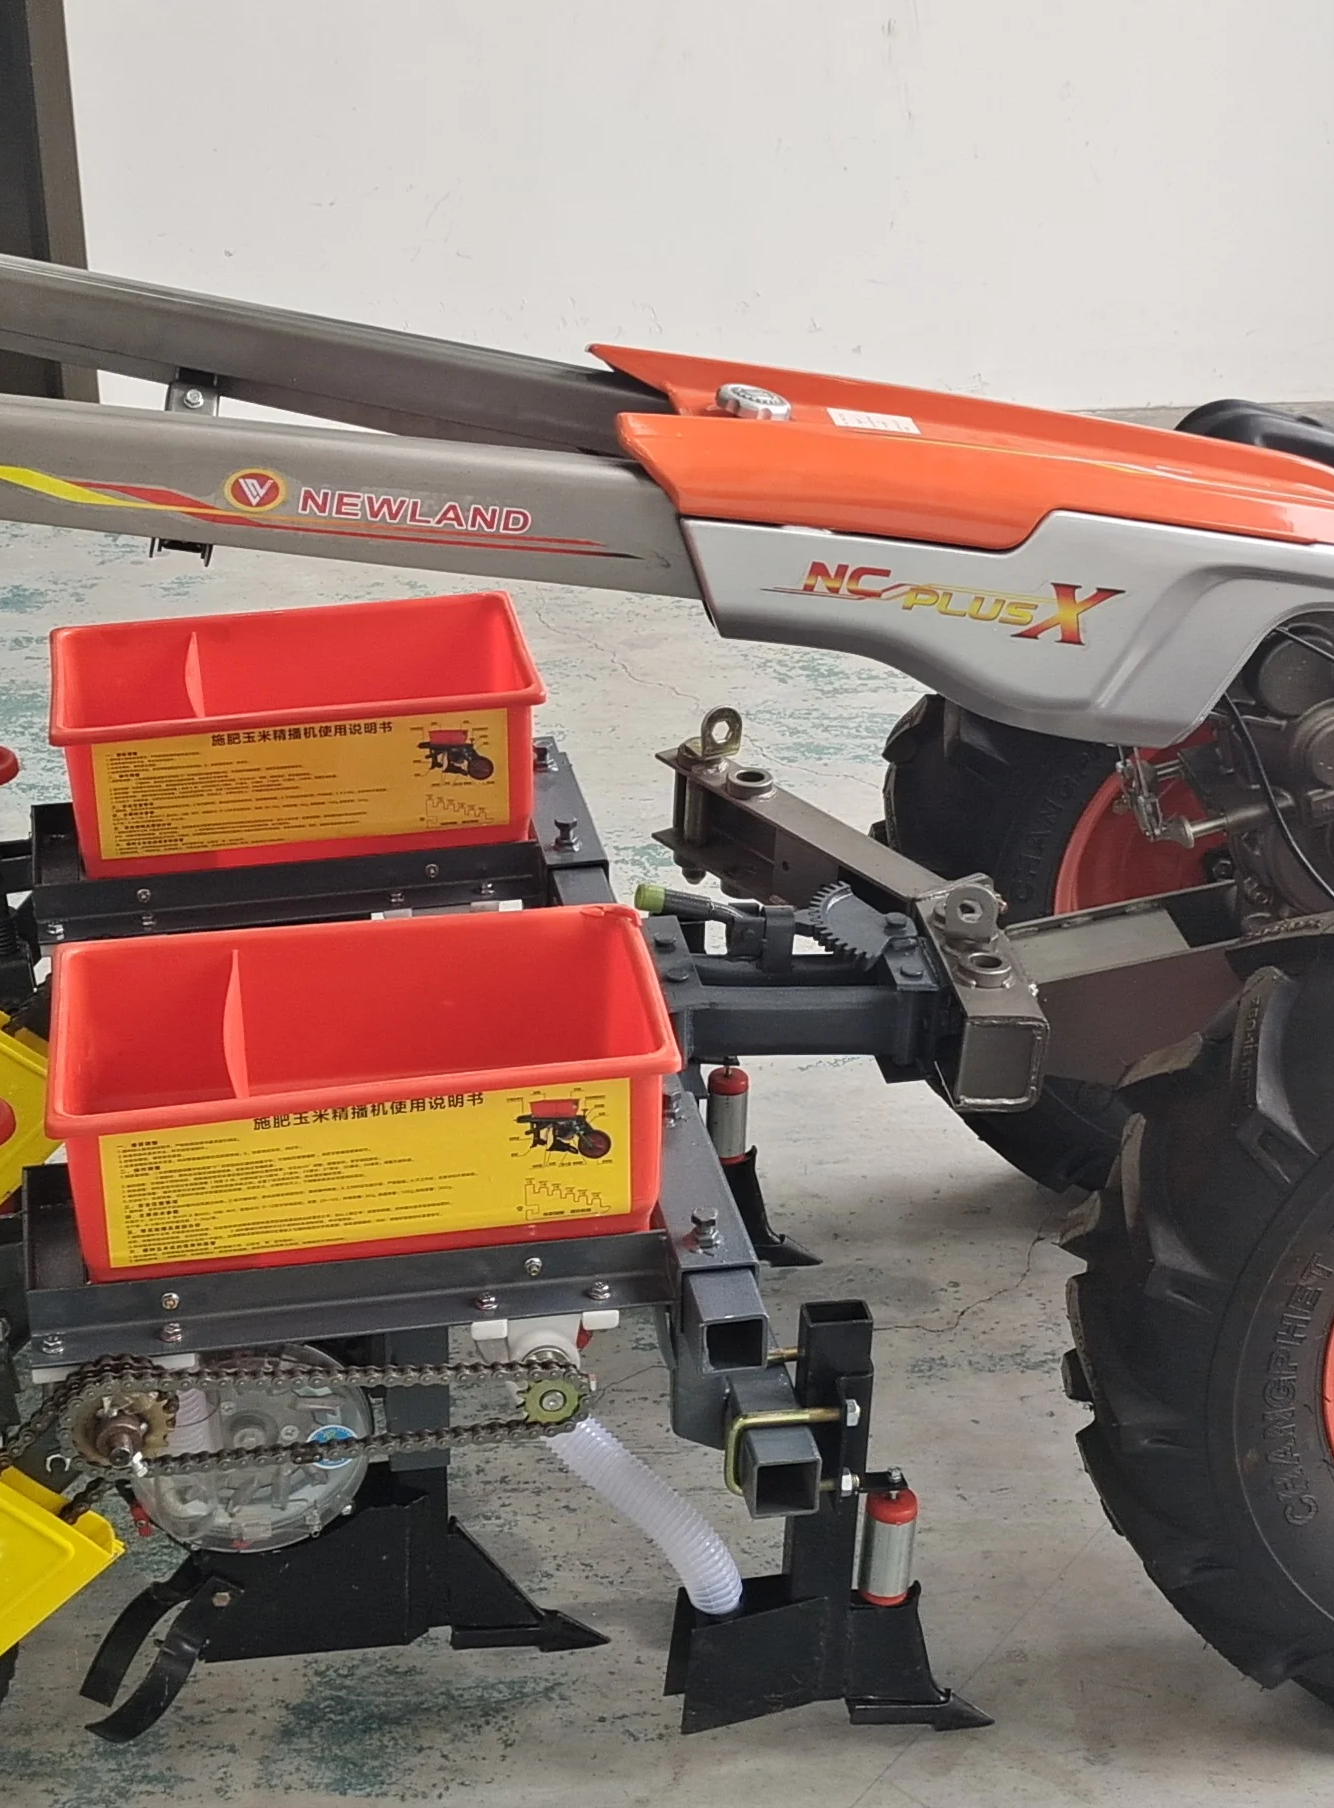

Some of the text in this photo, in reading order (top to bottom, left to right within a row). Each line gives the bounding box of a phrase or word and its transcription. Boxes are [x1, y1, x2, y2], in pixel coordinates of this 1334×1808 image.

[298, 487, 533, 535] NEWLAND
[803, 560, 1127, 646] NC PLUS X
[211, 721, 394, 747] 施肥玉米精播机使用说明书
[253, 1092, 484, 1131] 施肥玉米精播机使用说明书
